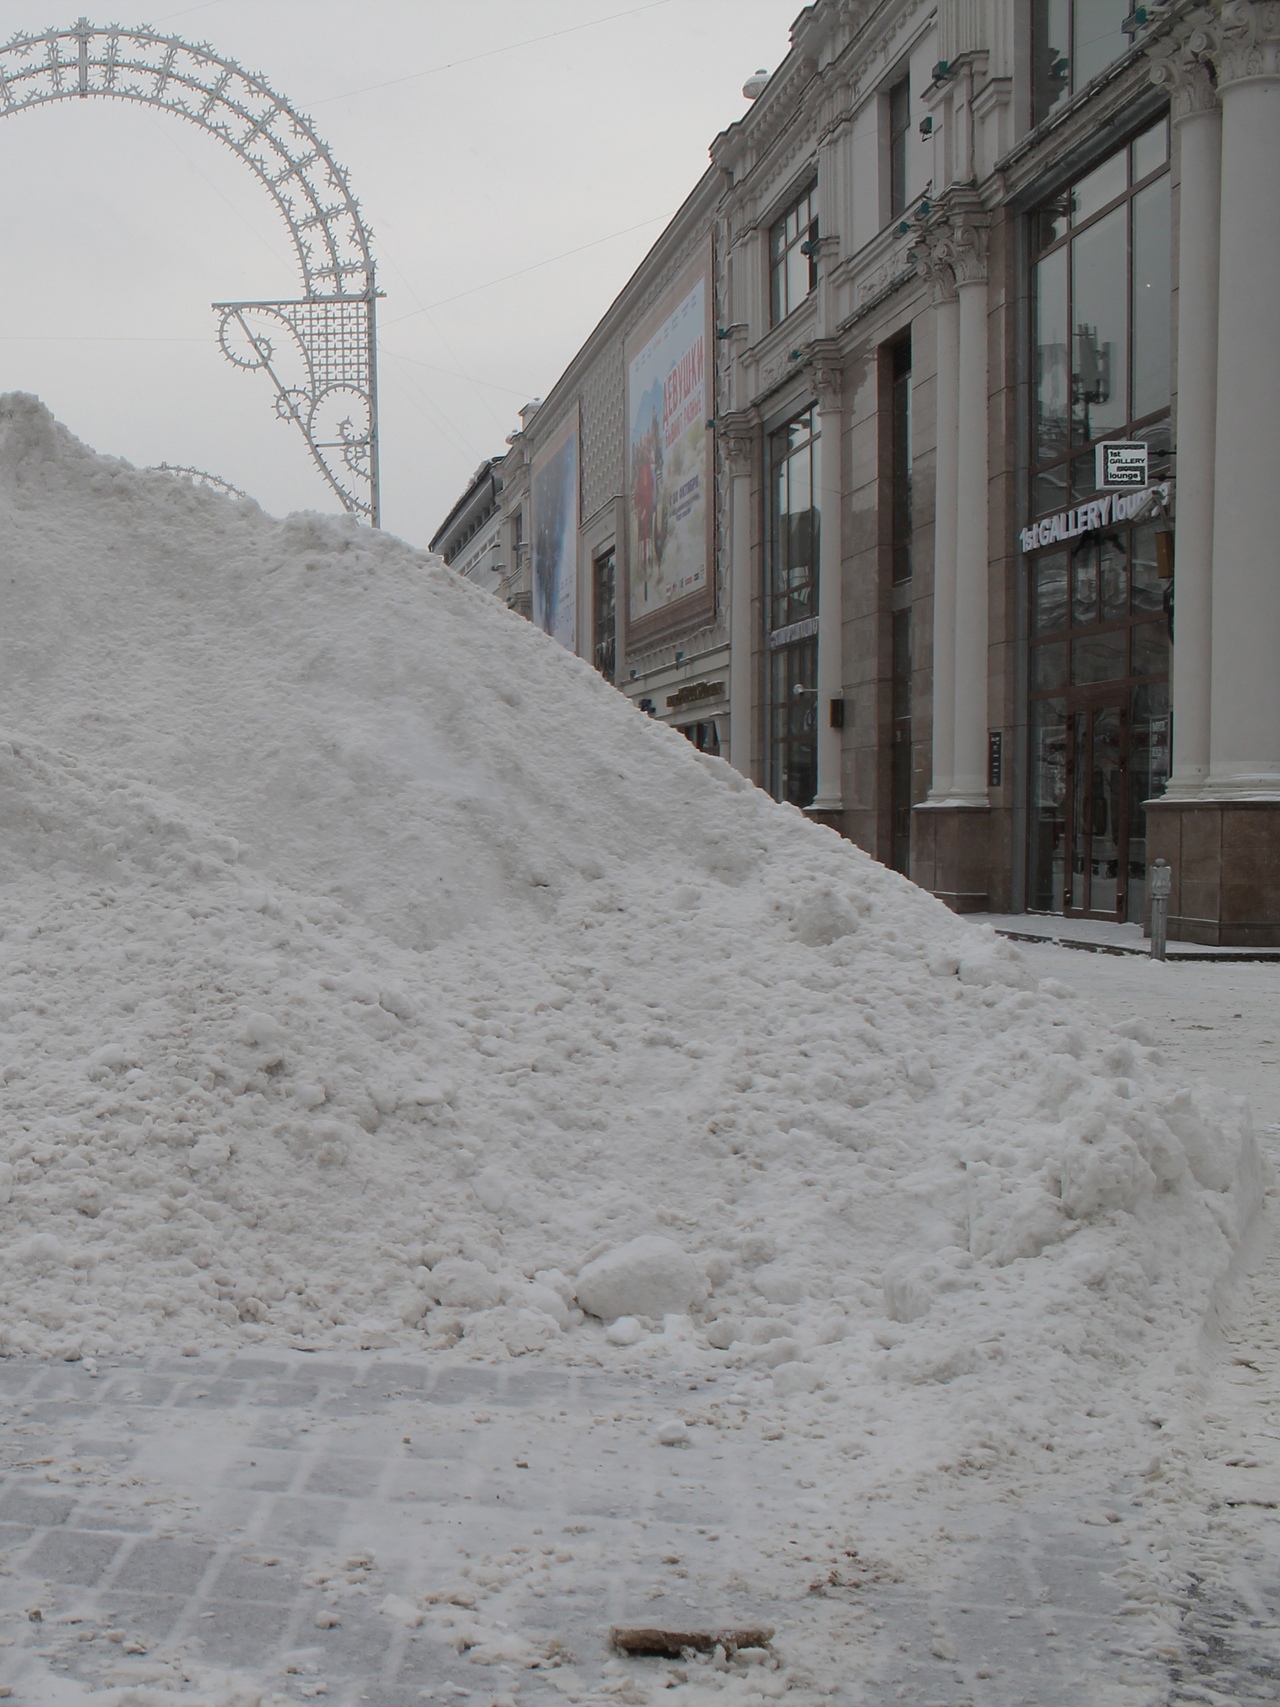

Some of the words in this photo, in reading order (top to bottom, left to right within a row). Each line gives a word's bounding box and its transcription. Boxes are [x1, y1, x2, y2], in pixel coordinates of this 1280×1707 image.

[662, 335, 703, 432] ДЕВУШКИ
[1110, 472, 1138, 480] lounge
[1020, 523, 1040, 552] 1st
[1039, 496, 1111, 546] GALLERY
